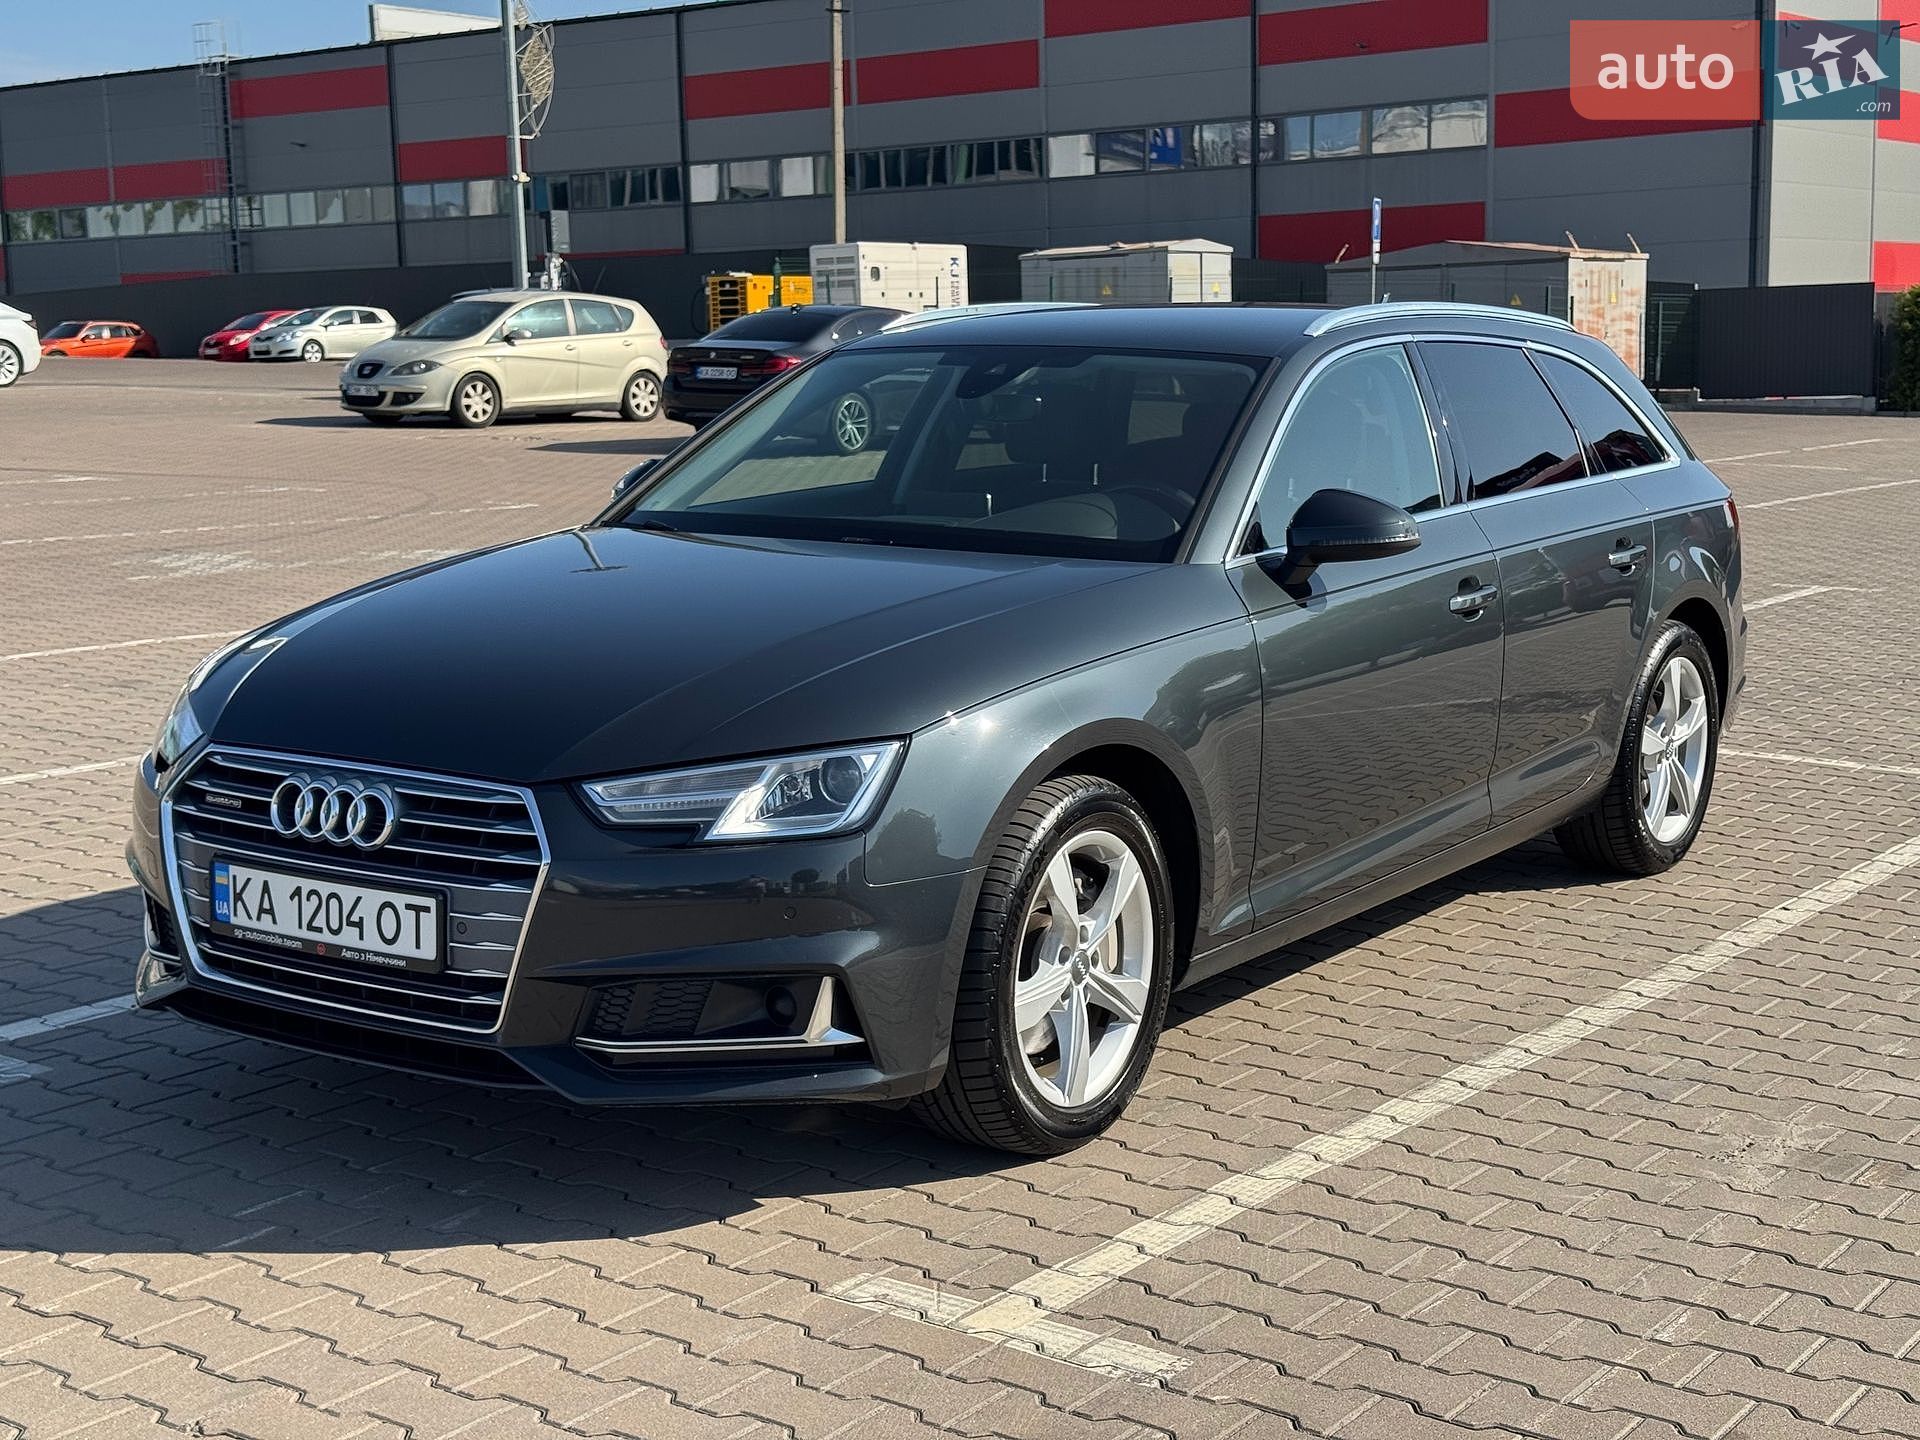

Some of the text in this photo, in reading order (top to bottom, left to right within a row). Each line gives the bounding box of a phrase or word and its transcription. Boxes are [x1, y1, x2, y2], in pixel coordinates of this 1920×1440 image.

[215, 900, 230, 916] UA
[232, 874, 432, 950] KA 1204 OT
